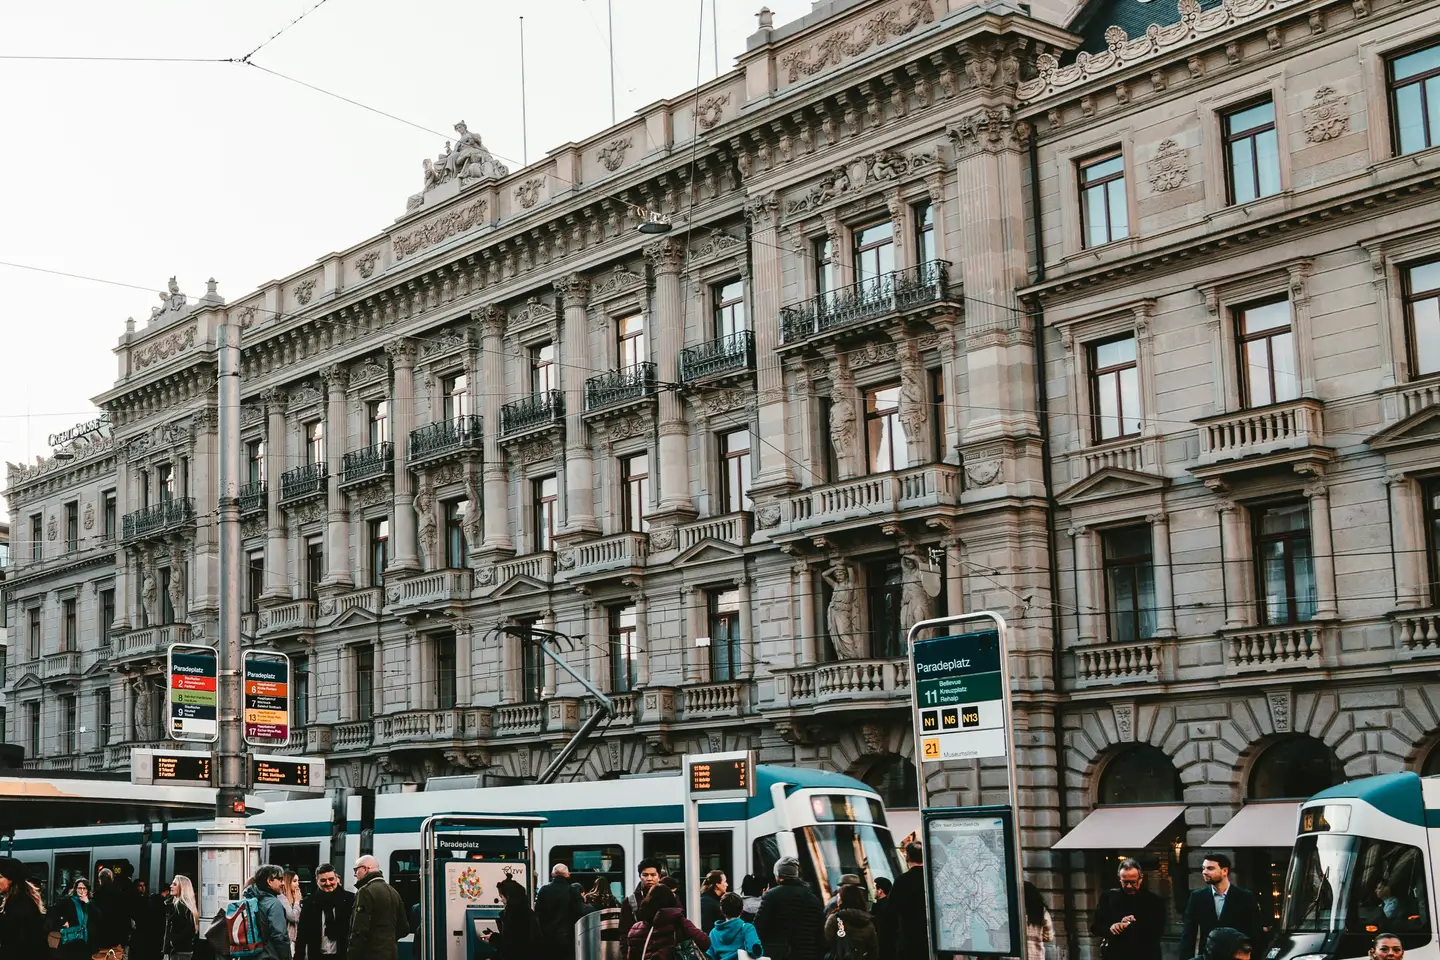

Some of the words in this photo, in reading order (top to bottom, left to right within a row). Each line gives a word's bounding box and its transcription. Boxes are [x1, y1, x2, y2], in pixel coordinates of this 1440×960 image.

[174, 665, 204, 674] Paradeplatz
[916, 658, 971, 673] Paradeplatz
[247, 671, 275, 680] Paradeplatz
[940, 686, 968, 695] Kreuzplatz
[925, 690, 937, 704] 11
[924, 717, 935, 726] N1
[944, 715, 956, 724] N6
[963, 713, 978, 723] N13
[925, 743, 938, 755] 21
[944, 750, 978, 758] Museumslinie
